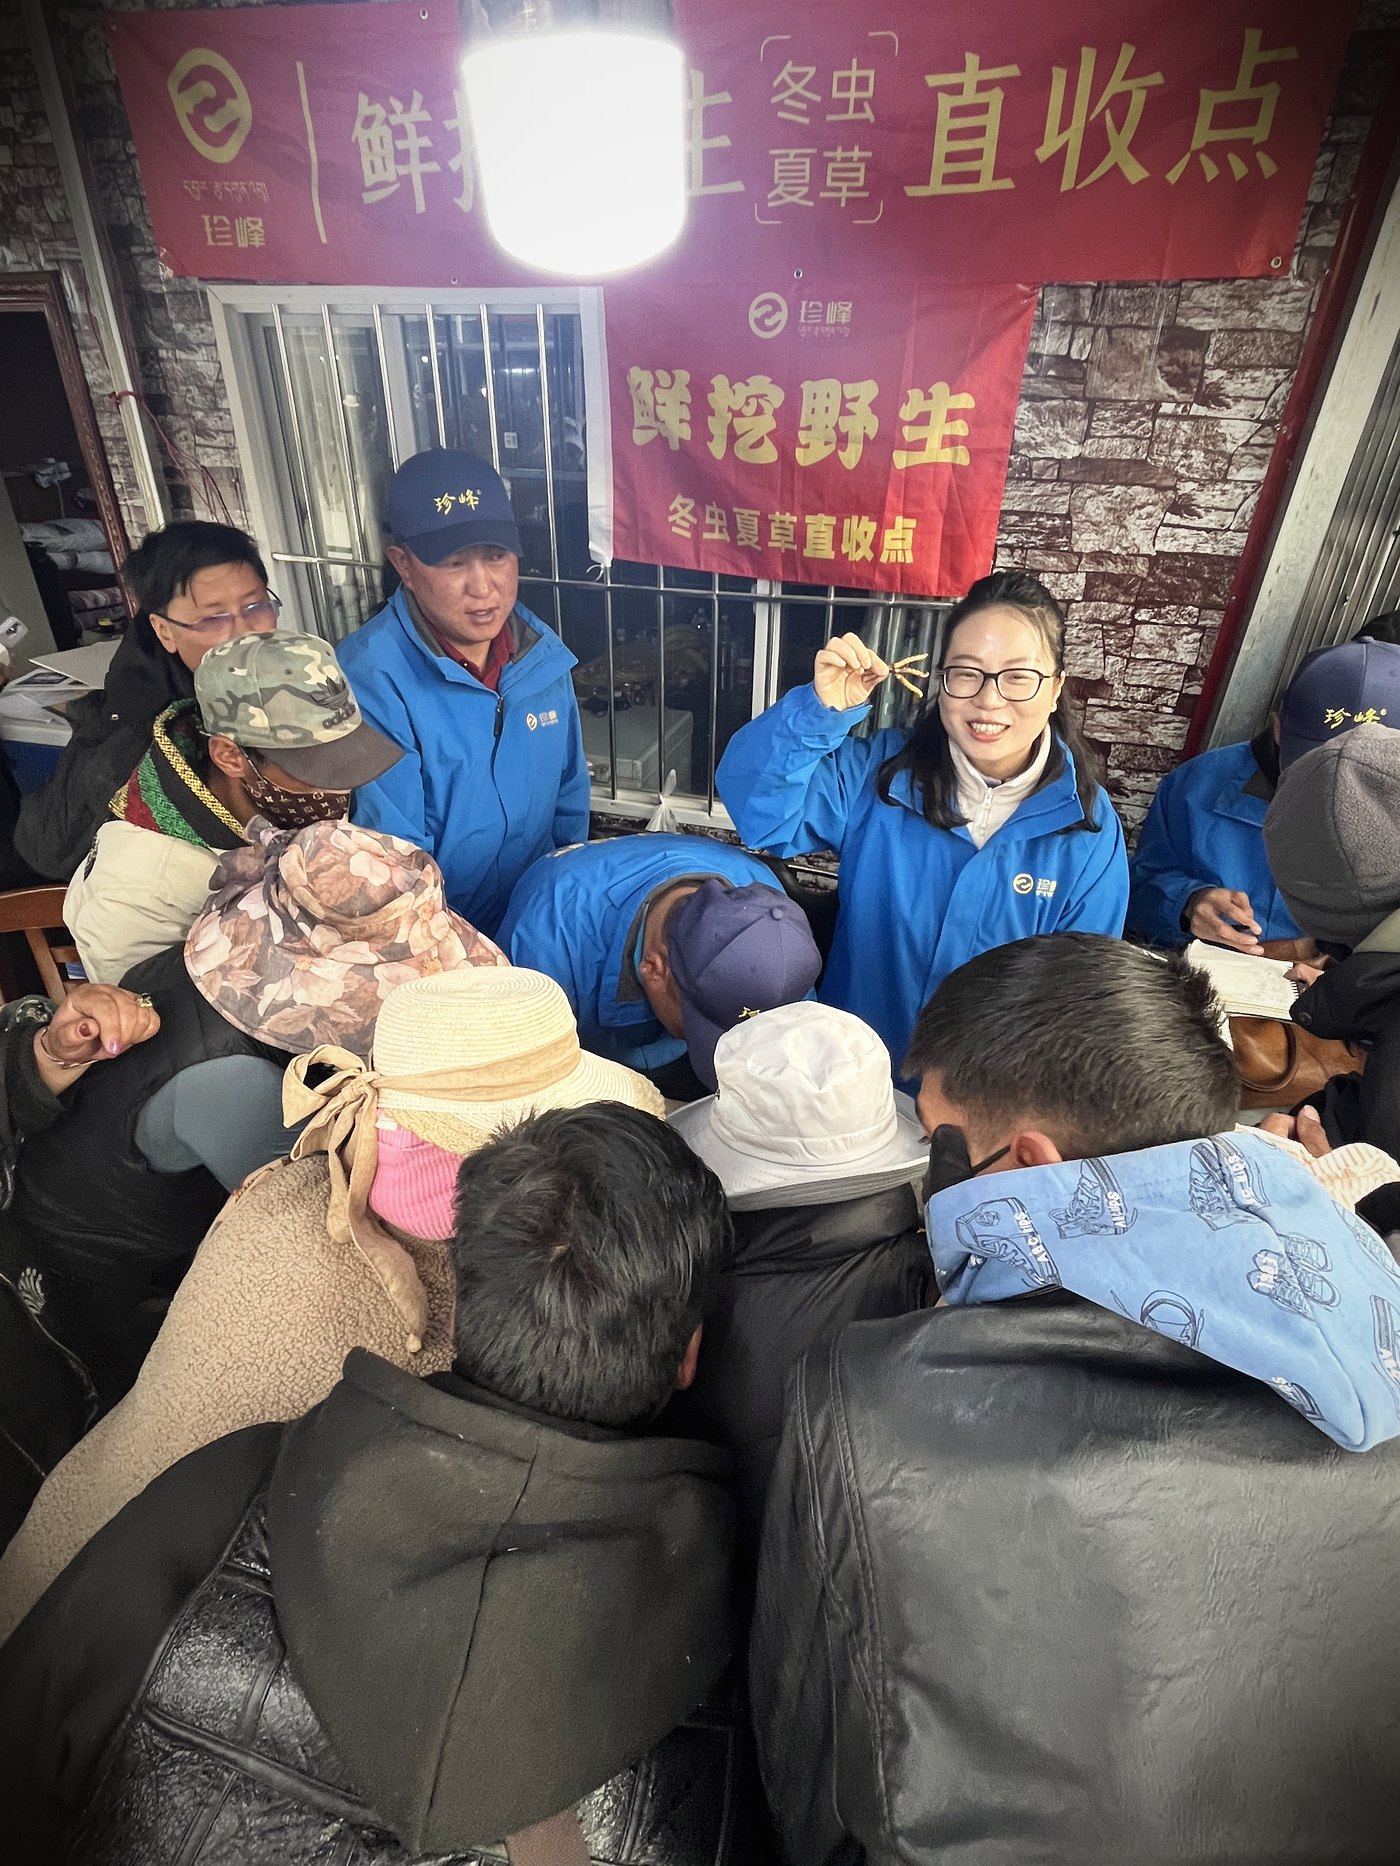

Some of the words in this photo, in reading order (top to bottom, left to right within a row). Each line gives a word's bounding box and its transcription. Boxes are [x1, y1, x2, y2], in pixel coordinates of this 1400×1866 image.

[770, 57, 876, 125] 冬虫
[904, 28, 1299, 197] 直收点
[766, 145, 873, 208] 夏草
[201, 214, 266, 248] 珍峰
[800, 300, 853, 324] 珍峰
[626, 366, 976, 470] 鲜挖野生
[433, 488, 480, 515] 珍峰
[667, 493, 917, 564] 冬虫夏草直收点
